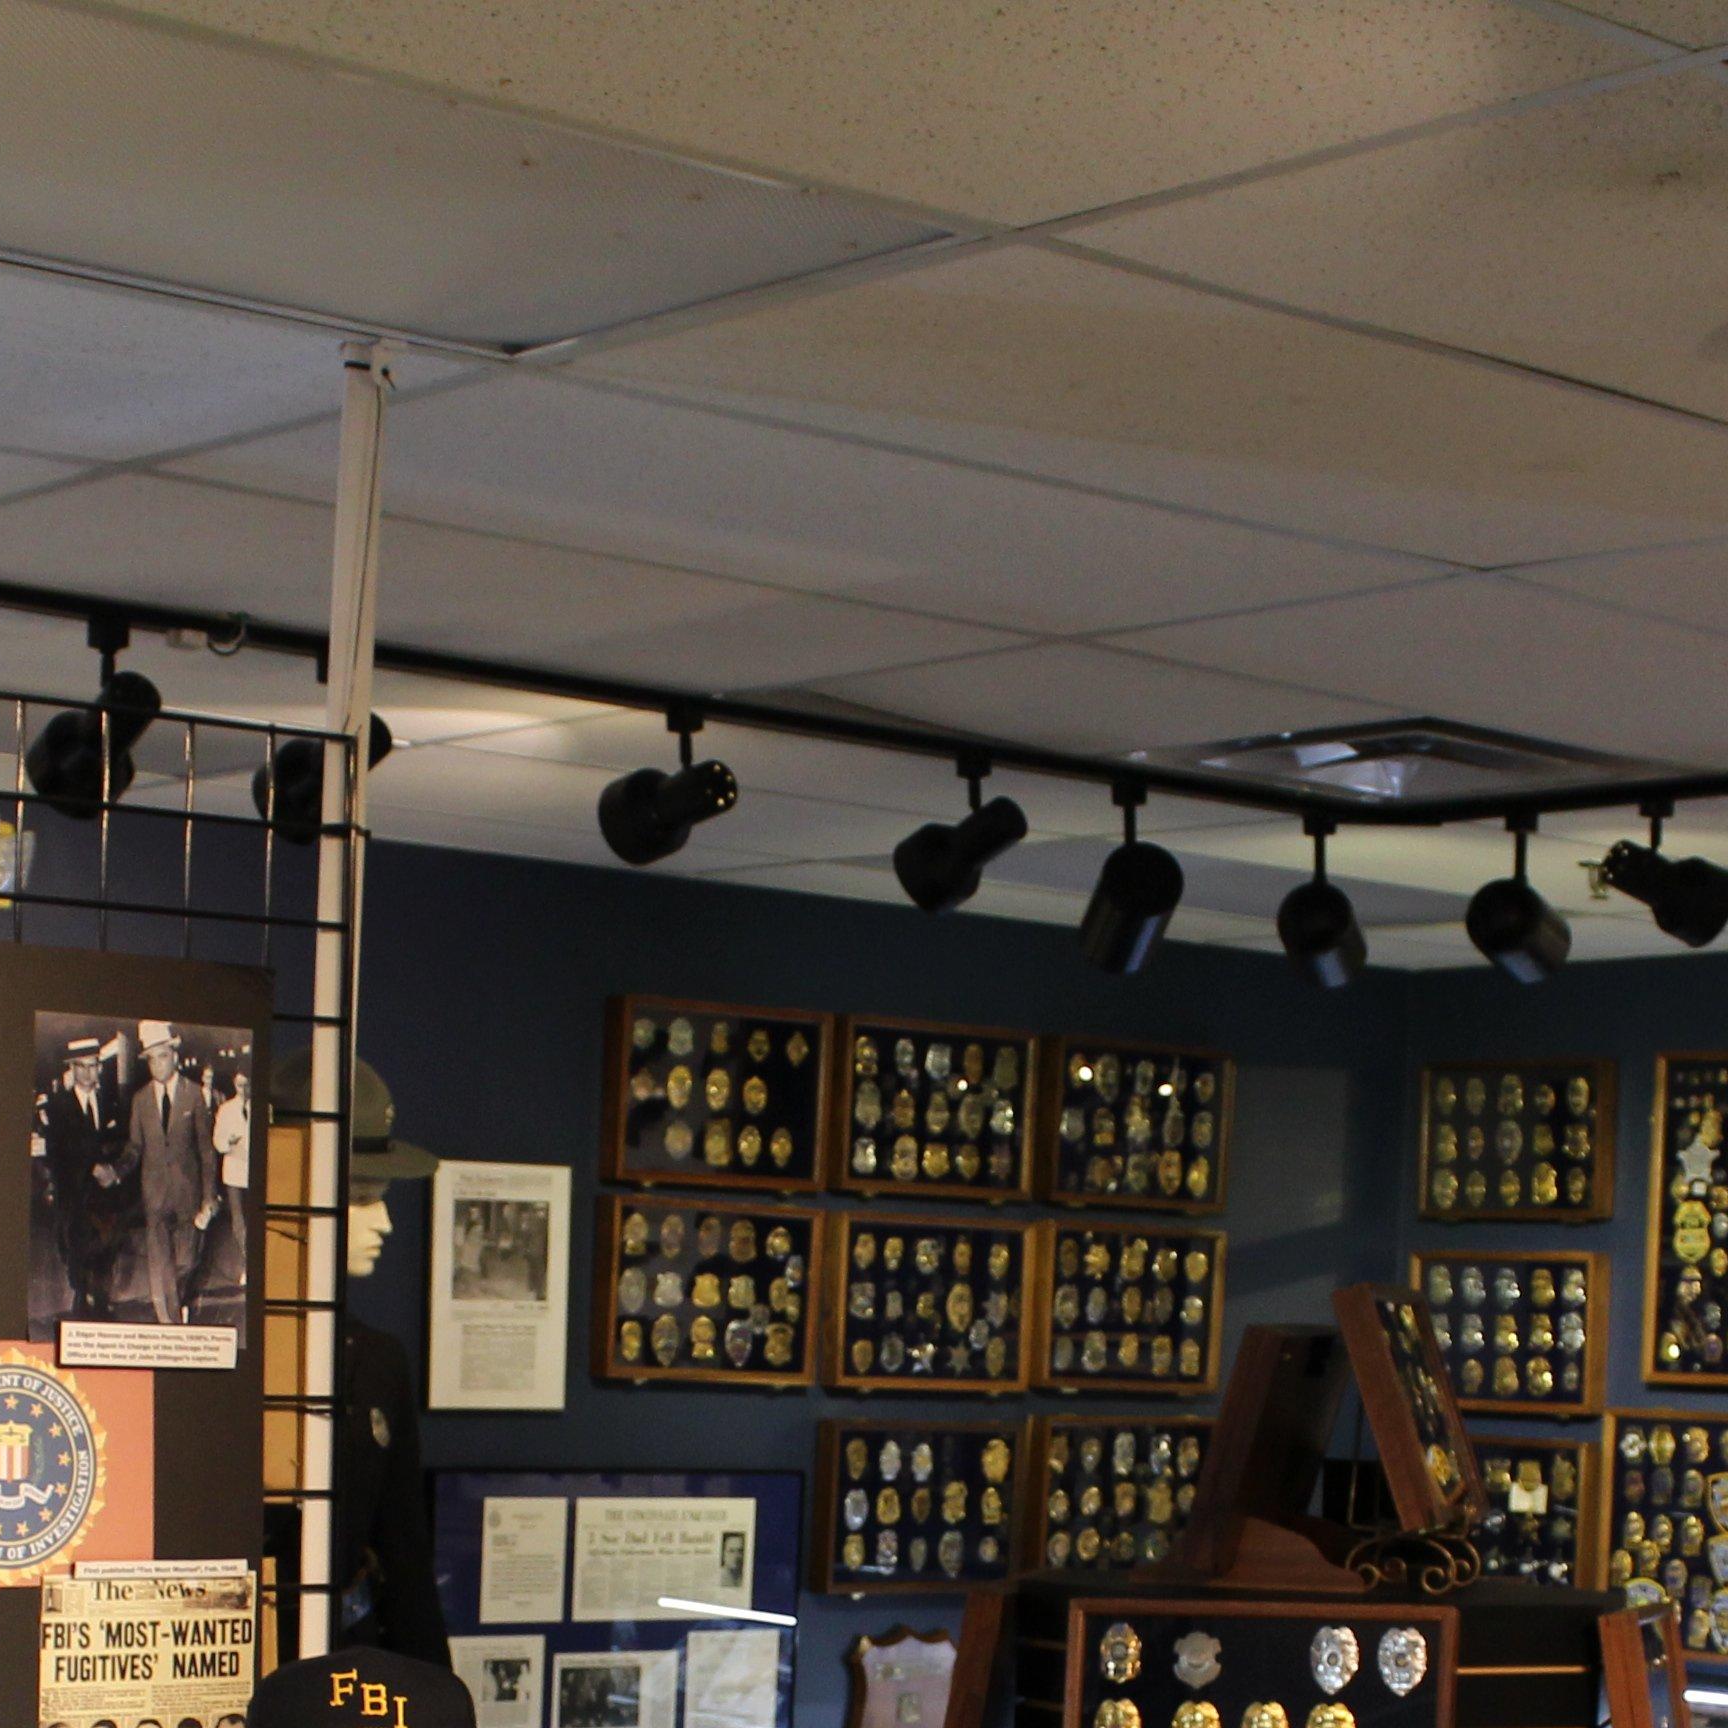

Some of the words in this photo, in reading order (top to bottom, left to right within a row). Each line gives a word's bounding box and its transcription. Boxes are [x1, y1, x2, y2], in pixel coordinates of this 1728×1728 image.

[23, 1375, 40, 1391] OF
[41, 1386, 83, 1438] JUSTICE
[7, 1545, 25, 1559] OF
[30, 1450, 90, 1556] INVESTIGATION
[91, 1581, 133, 1600] The
[153, 1579, 207, 1600] News
[42, 1621, 91, 1649] FBI'S
[99, 1618, 252, 1648] 'MOST-WANTED
[55, 1654, 158, 1682] FUGITIVES'
[173, 1651, 240, 1679] NAMED
